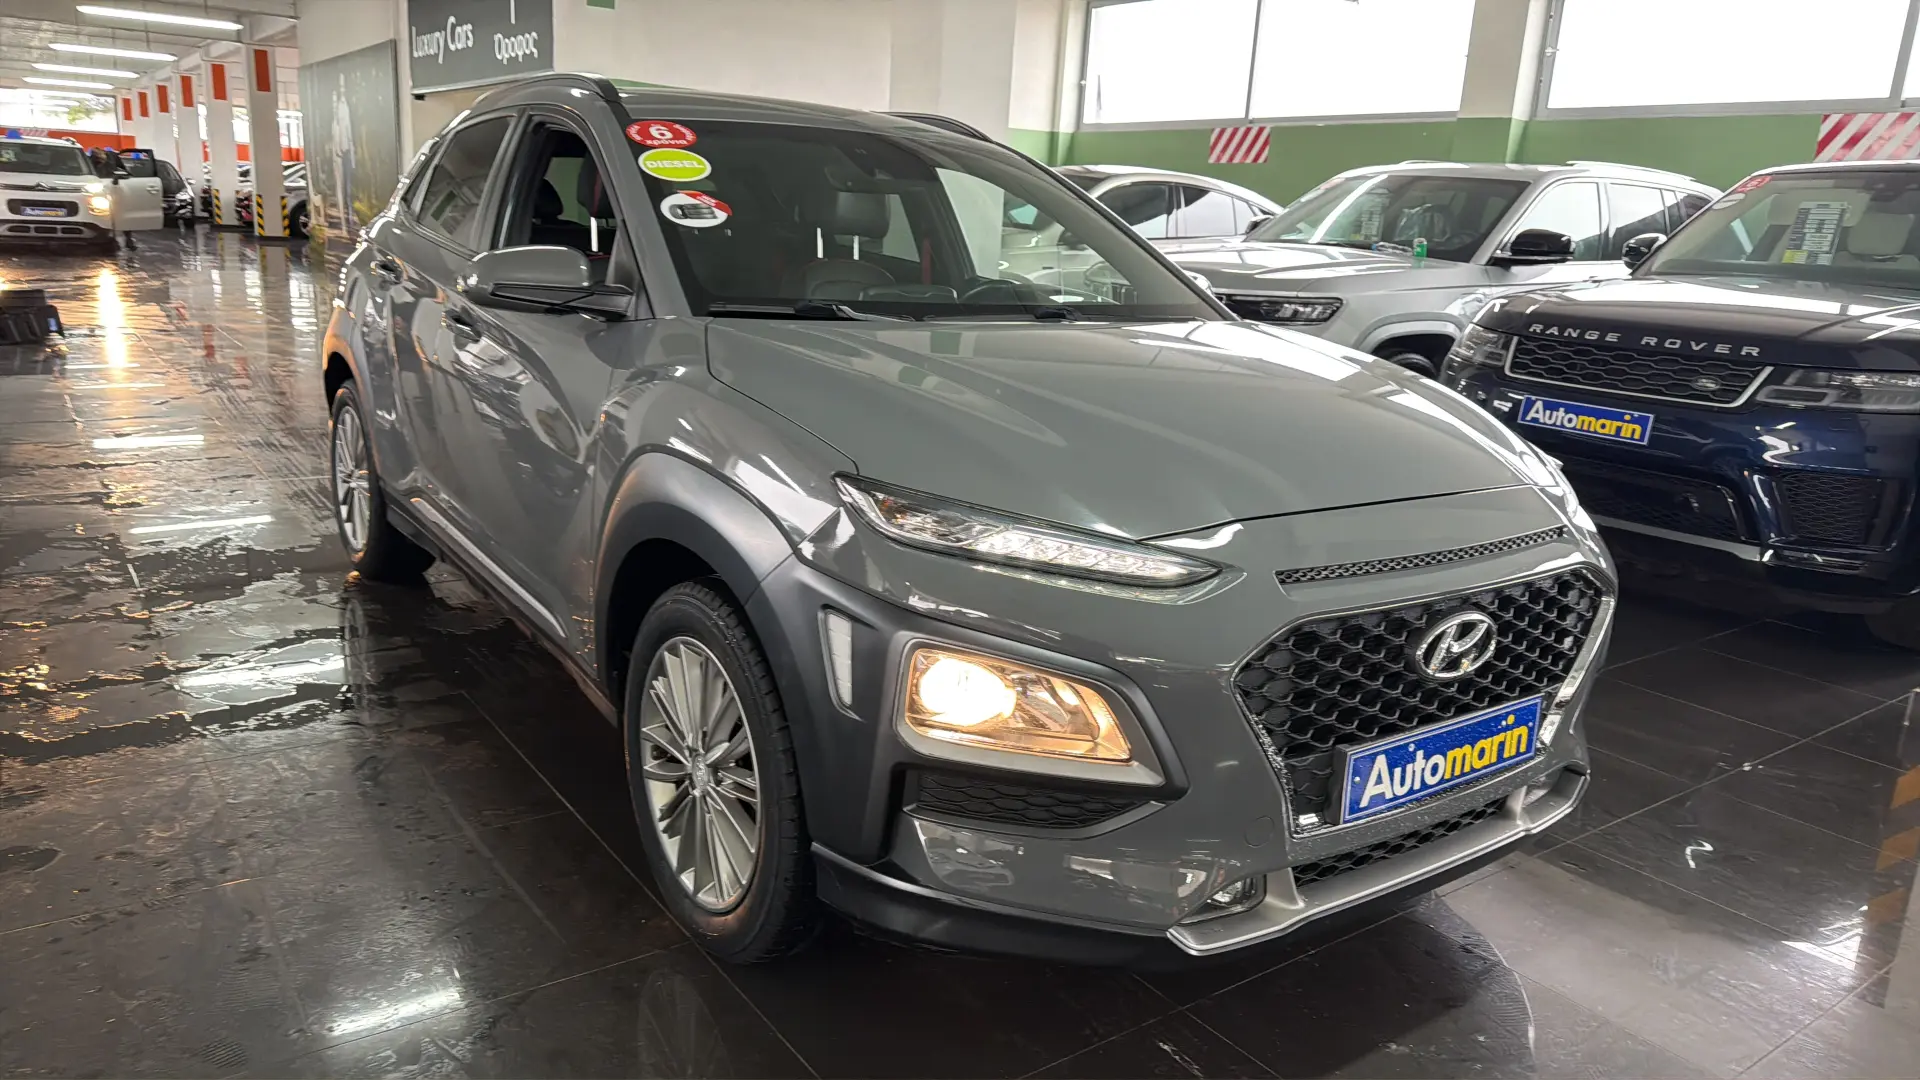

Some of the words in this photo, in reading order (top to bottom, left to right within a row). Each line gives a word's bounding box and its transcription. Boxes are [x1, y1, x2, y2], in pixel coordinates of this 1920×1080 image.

[412, 26, 445, 64] Luxury
[447, 15, 473, 51] Cars
[648, 125, 673, 140] 6
[645, 160, 705, 168] DIESEL
[1529, 323, 1621, 342] RANGE
[1640, 336, 1760, 357] ROVER
[1525, 400, 1642, 440] Automarin
[1359, 714, 1529, 808] Automarin
